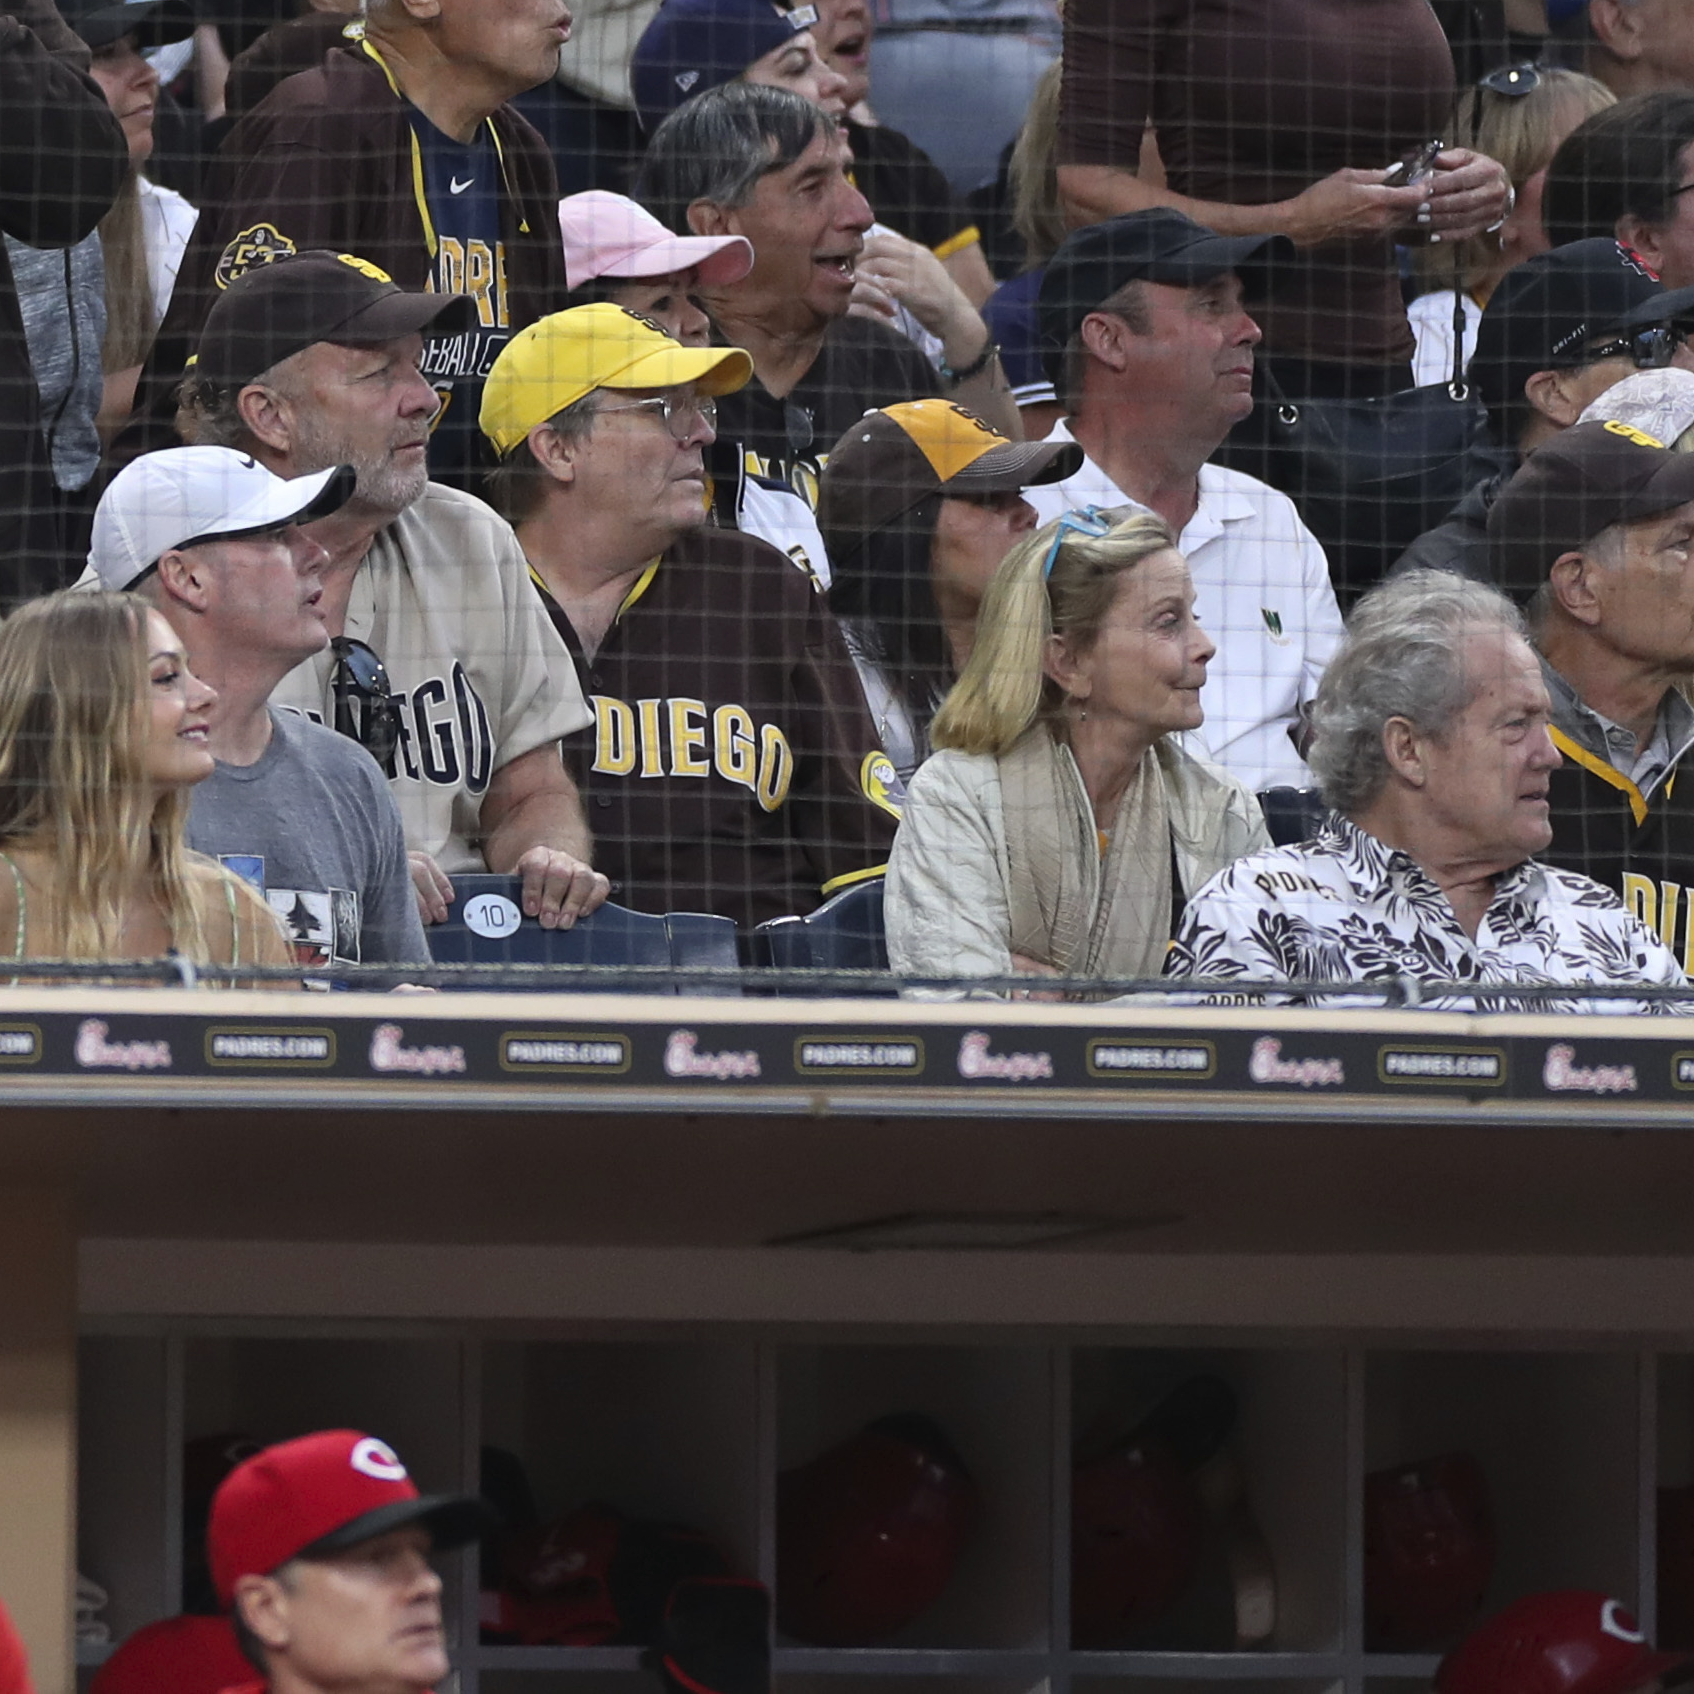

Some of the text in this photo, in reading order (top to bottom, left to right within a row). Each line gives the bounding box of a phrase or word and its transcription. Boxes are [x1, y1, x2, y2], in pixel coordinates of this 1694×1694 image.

[1551, 322, 1588, 355] DRI-FIT
[589, 694, 795, 813] DIEGO
[479, 904, 506, 929] 10
[213, 1036, 328, 1058] PADRES.COM
[507, 1041, 623, 1064] PADRES.COM
[802, 1045, 916, 1067] PADRES.COM
[1095, 1047, 1208, 1069] PADRES.COM
[1385, 1053, 1499, 1076] PADRES.COM
[350, 1436, 407, 1482] C
